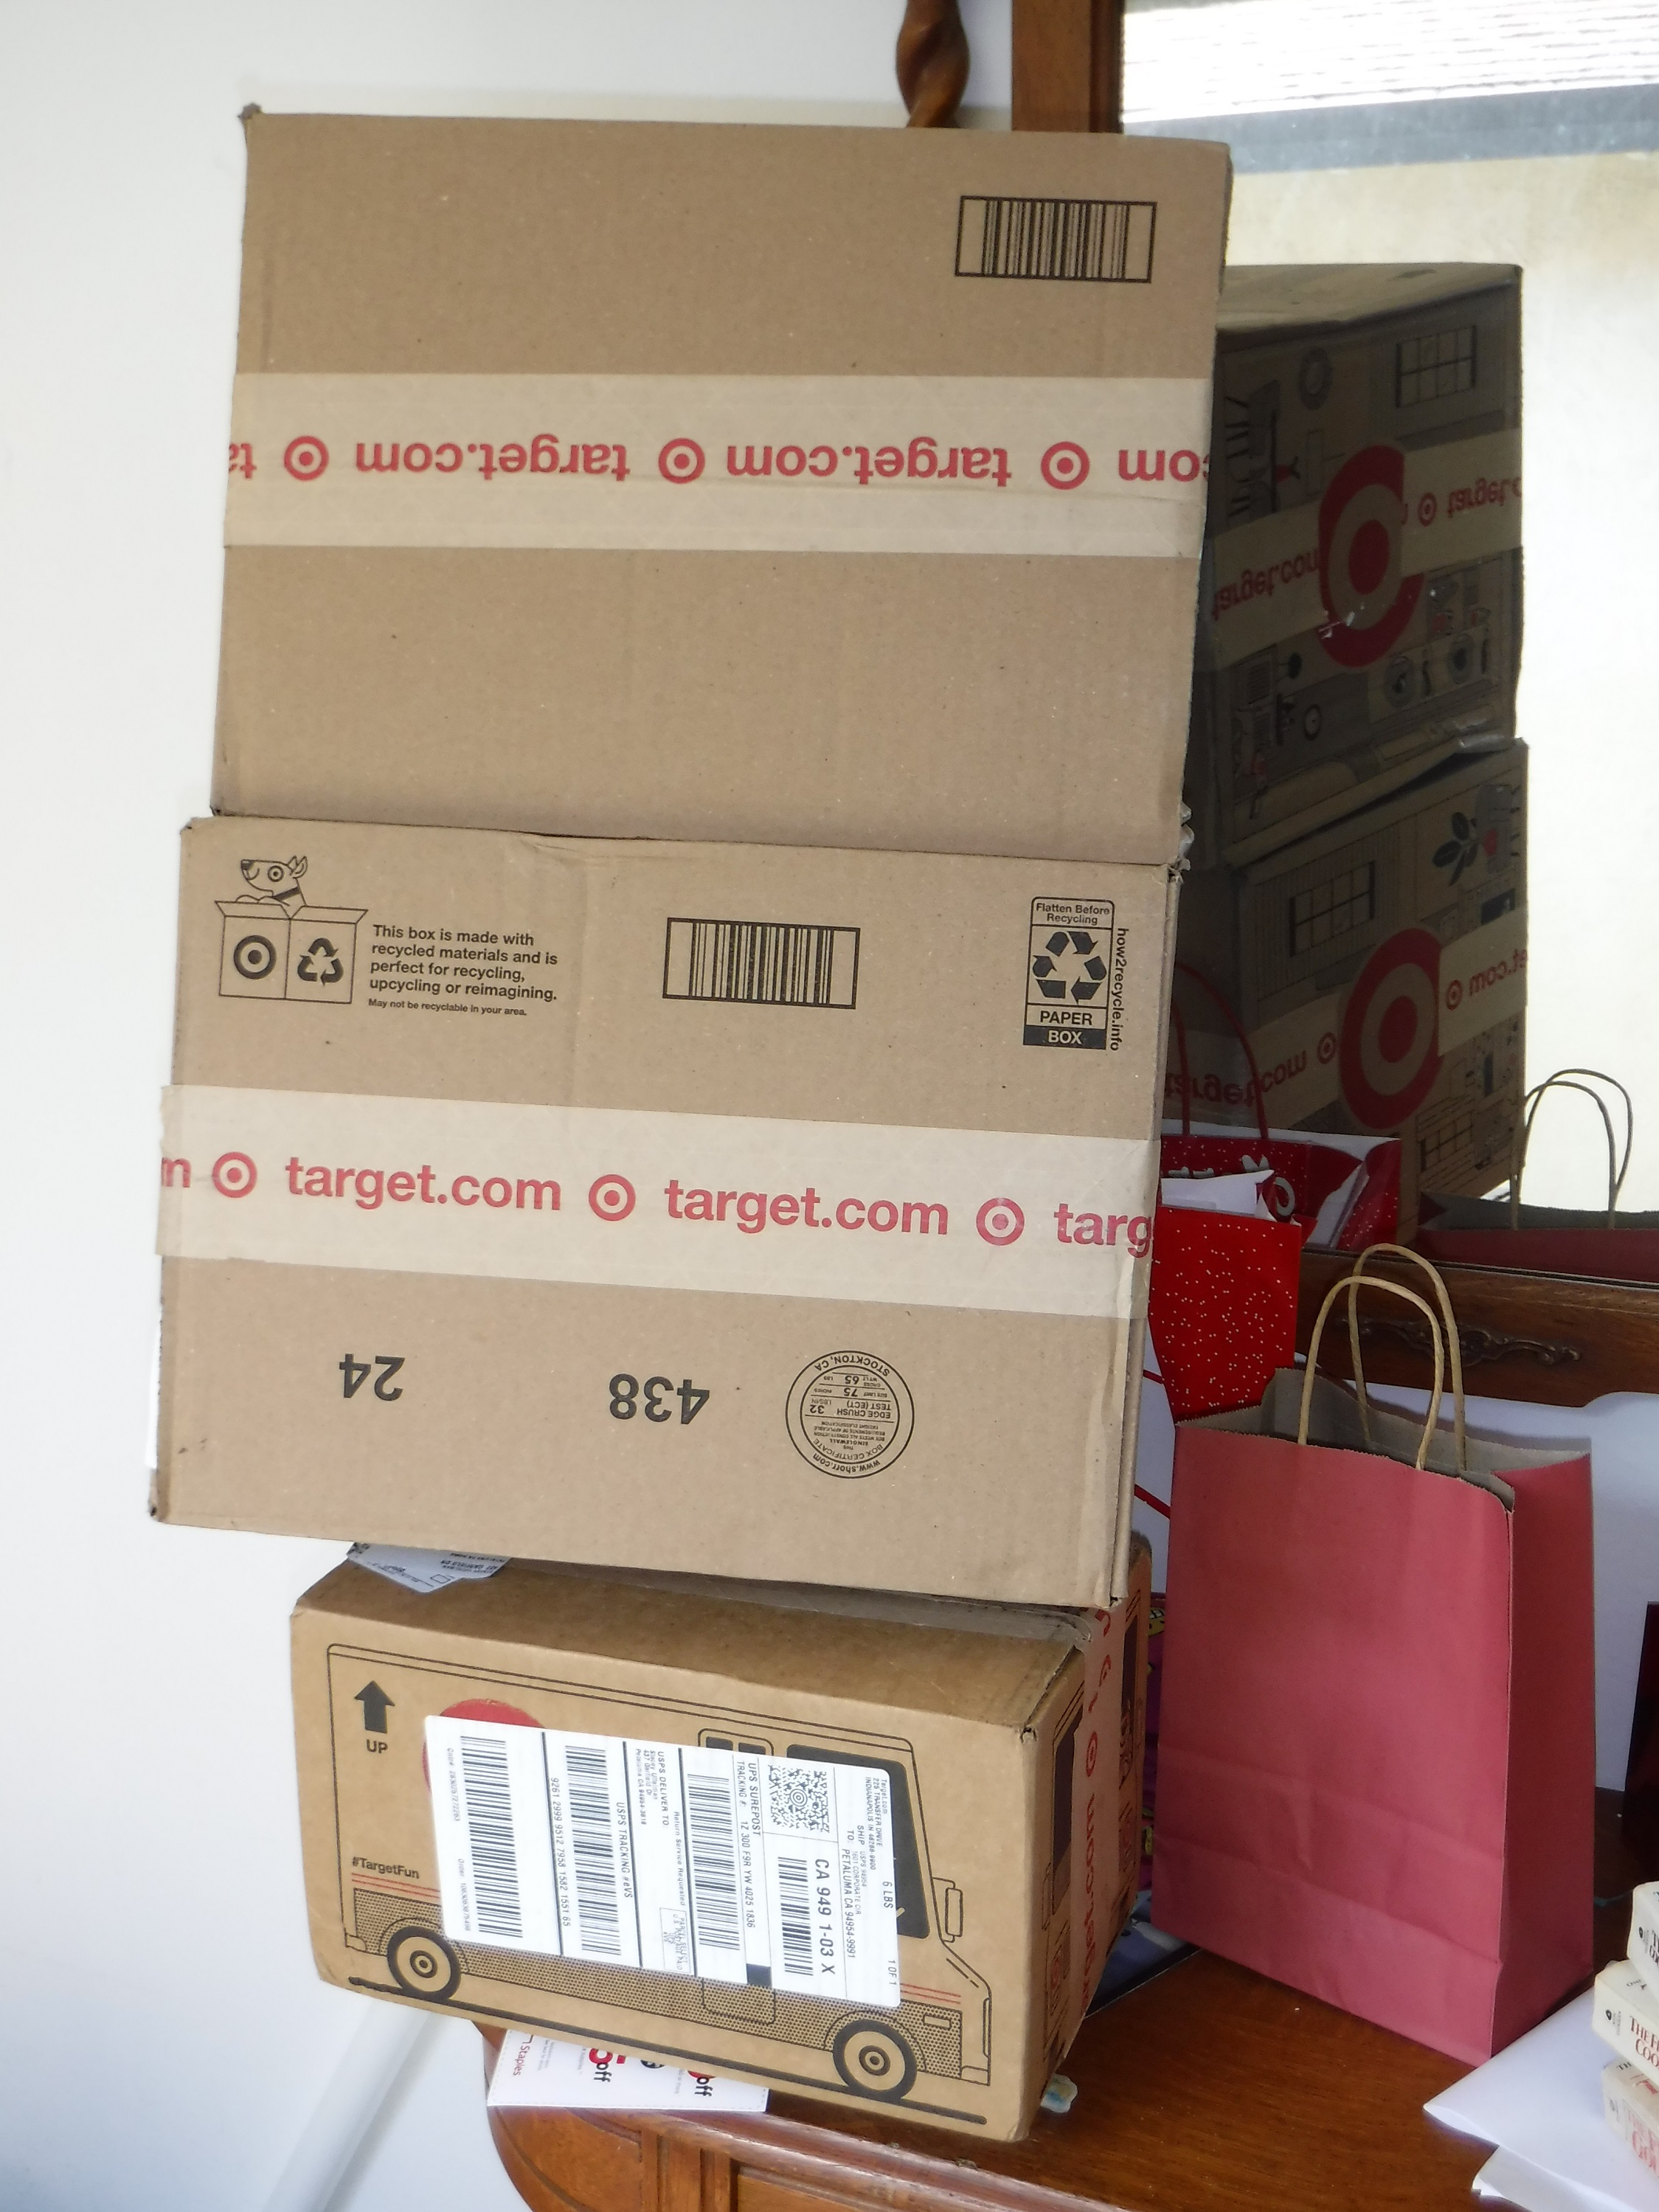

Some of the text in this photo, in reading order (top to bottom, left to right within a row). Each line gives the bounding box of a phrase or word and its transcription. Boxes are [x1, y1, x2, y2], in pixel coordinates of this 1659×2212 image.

[356, 434, 630, 481] target.com
[727, 437, 1012, 487] target.com
[1036, 902, 1110, 915] Flatten Before
[1047, 913, 1098, 926] Recycling
[373, 924, 534, 946] This box is made with
[371, 943, 558, 965] recycled materials and is
[370, 960, 525, 983] perfect for recycling,
[370, 979, 558, 1002] upcycling or reimagining.
[1110, 928, 1129, 1051] how2recycle.info
[368, 998, 527, 1016] May not be recyclable in your area.
[1040, 1010, 1092, 1025] PAPER
[1048, 1030, 1083, 1045] BOX
[285, 1157, 561, 1210] target.com
[665, 1179, 949, 1234] target.com
[814, 1355, 890, 1376] STOCKTON, CA
[339, 1353, 406, 1401] 24
[845, 1376, 859, 1384] 65
[609, 1373, 710, 1424] 438
[843, 1387, 858, 1396] 75
[810, 1405, 825, 1414] 32
[837, 1408, 890, 1418] EDGE CRUSH
[847, 1401, 868, 1409] (ECT)
[812, 1438, 883, 1460] BOX CERTIFICATE
[812, 1453, 881, 1474] www.shorr.com
[366, 1738, 388, 1754] UP
[657, 1751, 665, 1773] USPS
[637, 1778, 643, 1787] CA
[736, 1761, 747, 1797] TRACKING
[659, 1776, 668, 1811] DELIVER
[747, 1762, 761, 1836] UPS SUREPOST
[879, 1779, 888, 1814] Target.com
[616, 1802, 626, 1826] USPS
[740, 1820, 749, 1830] 1Z
[856, 1825, 865, 1845] SHIP
[741, 1832, 749, 1848] 300
[550, 1777, 570, 1927] 9261 2999 9512 7958 1582 1551 65
[618, 1829, 629, 1873] TRACKING
[742, 1851, 750, 1866] F9R
[352, 1856, 420, 1879] #TargetFun
[744, 1869, 752, 1884] YW
[676, 1867, 685, 1905] Requested
[744, 1886, 753, 1906] 4025
[841, 1848, 856, 1958] PETALUMA CA 94954-9991
[883, 1890, 892, 1908] LBS
[746, 1909, 754, 1928] 1836
[814, 1858, 834, 1974] CA 949 1-03 X
[887, 1966, 896, 1977] OF
[513, 2045, 530, 2076] Staples
[593, 2062, 612, 2083] off
[694, 2076, 713, 2097] off
